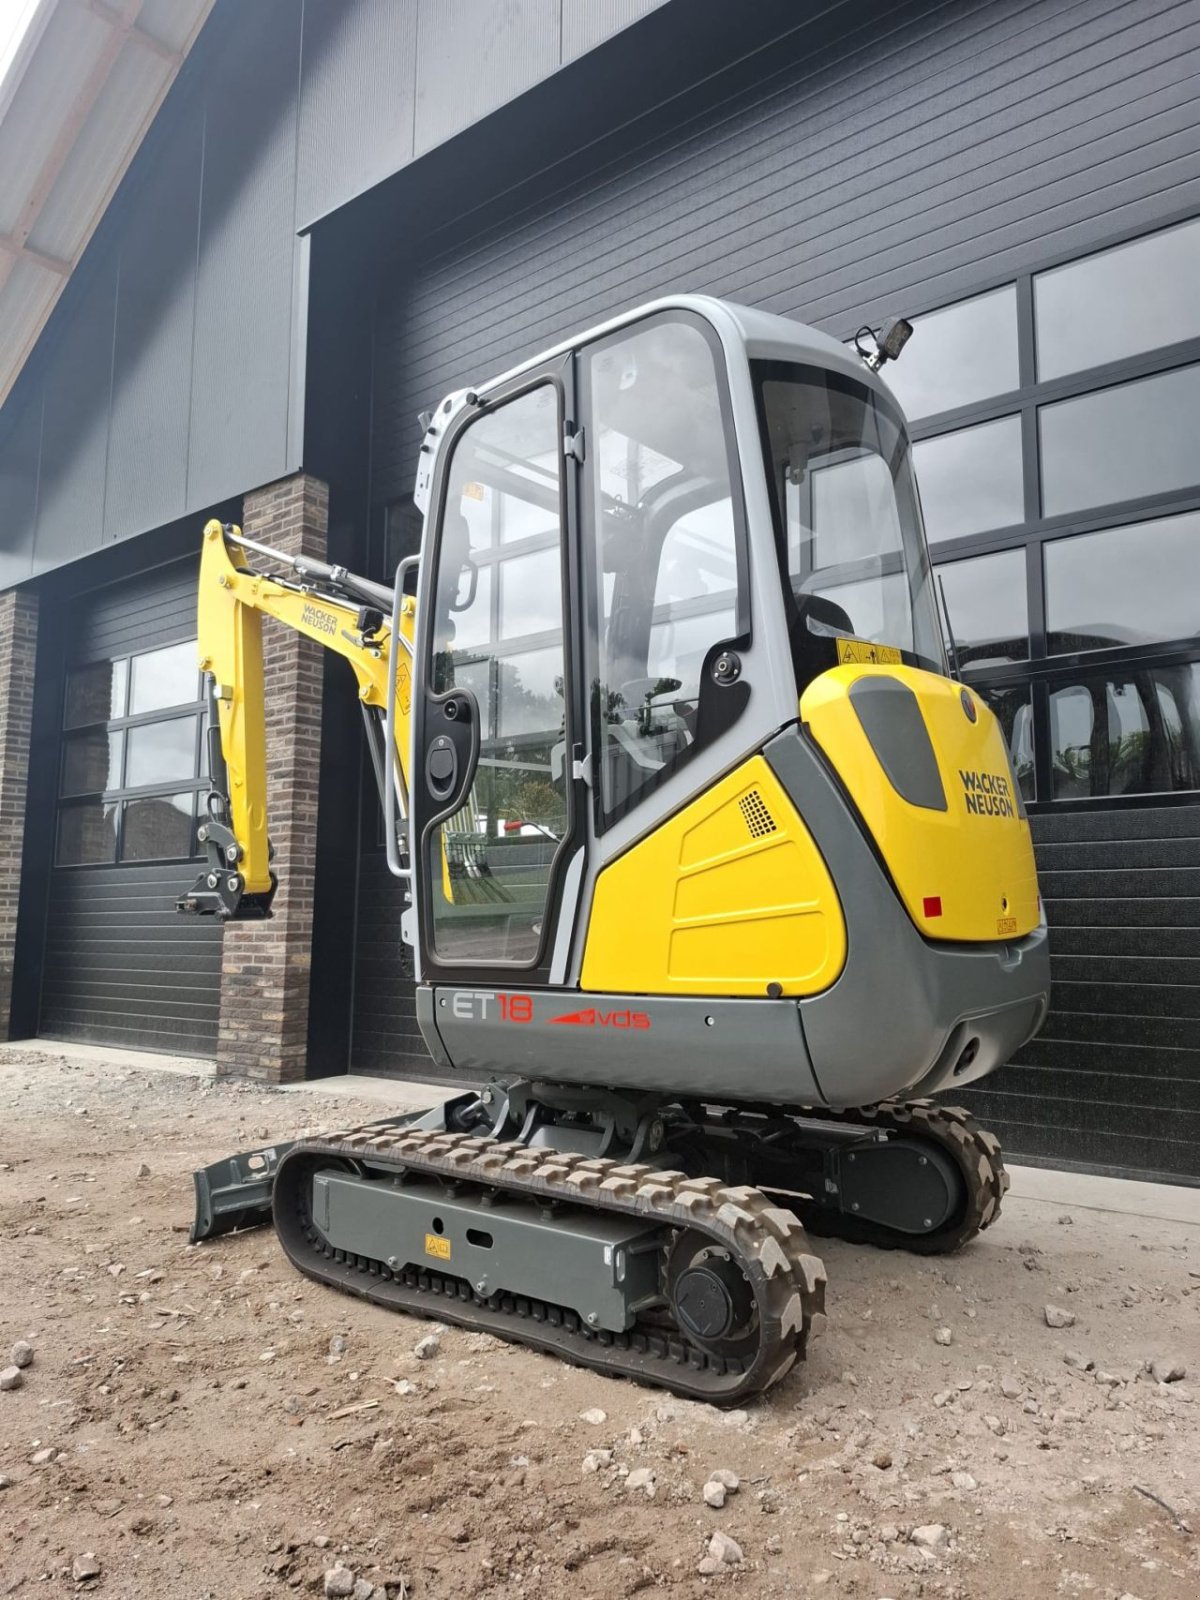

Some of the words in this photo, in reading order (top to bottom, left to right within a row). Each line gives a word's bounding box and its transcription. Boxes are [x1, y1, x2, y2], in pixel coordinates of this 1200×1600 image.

[301, 613, 337, 636] NEUSON
[304, 604, 338, 625] WACKER
[958, 769, 1011, 797] WACKER
[964, 792, 1014, 818] NEUSON
[452, 991, 533, 1023] ET18
